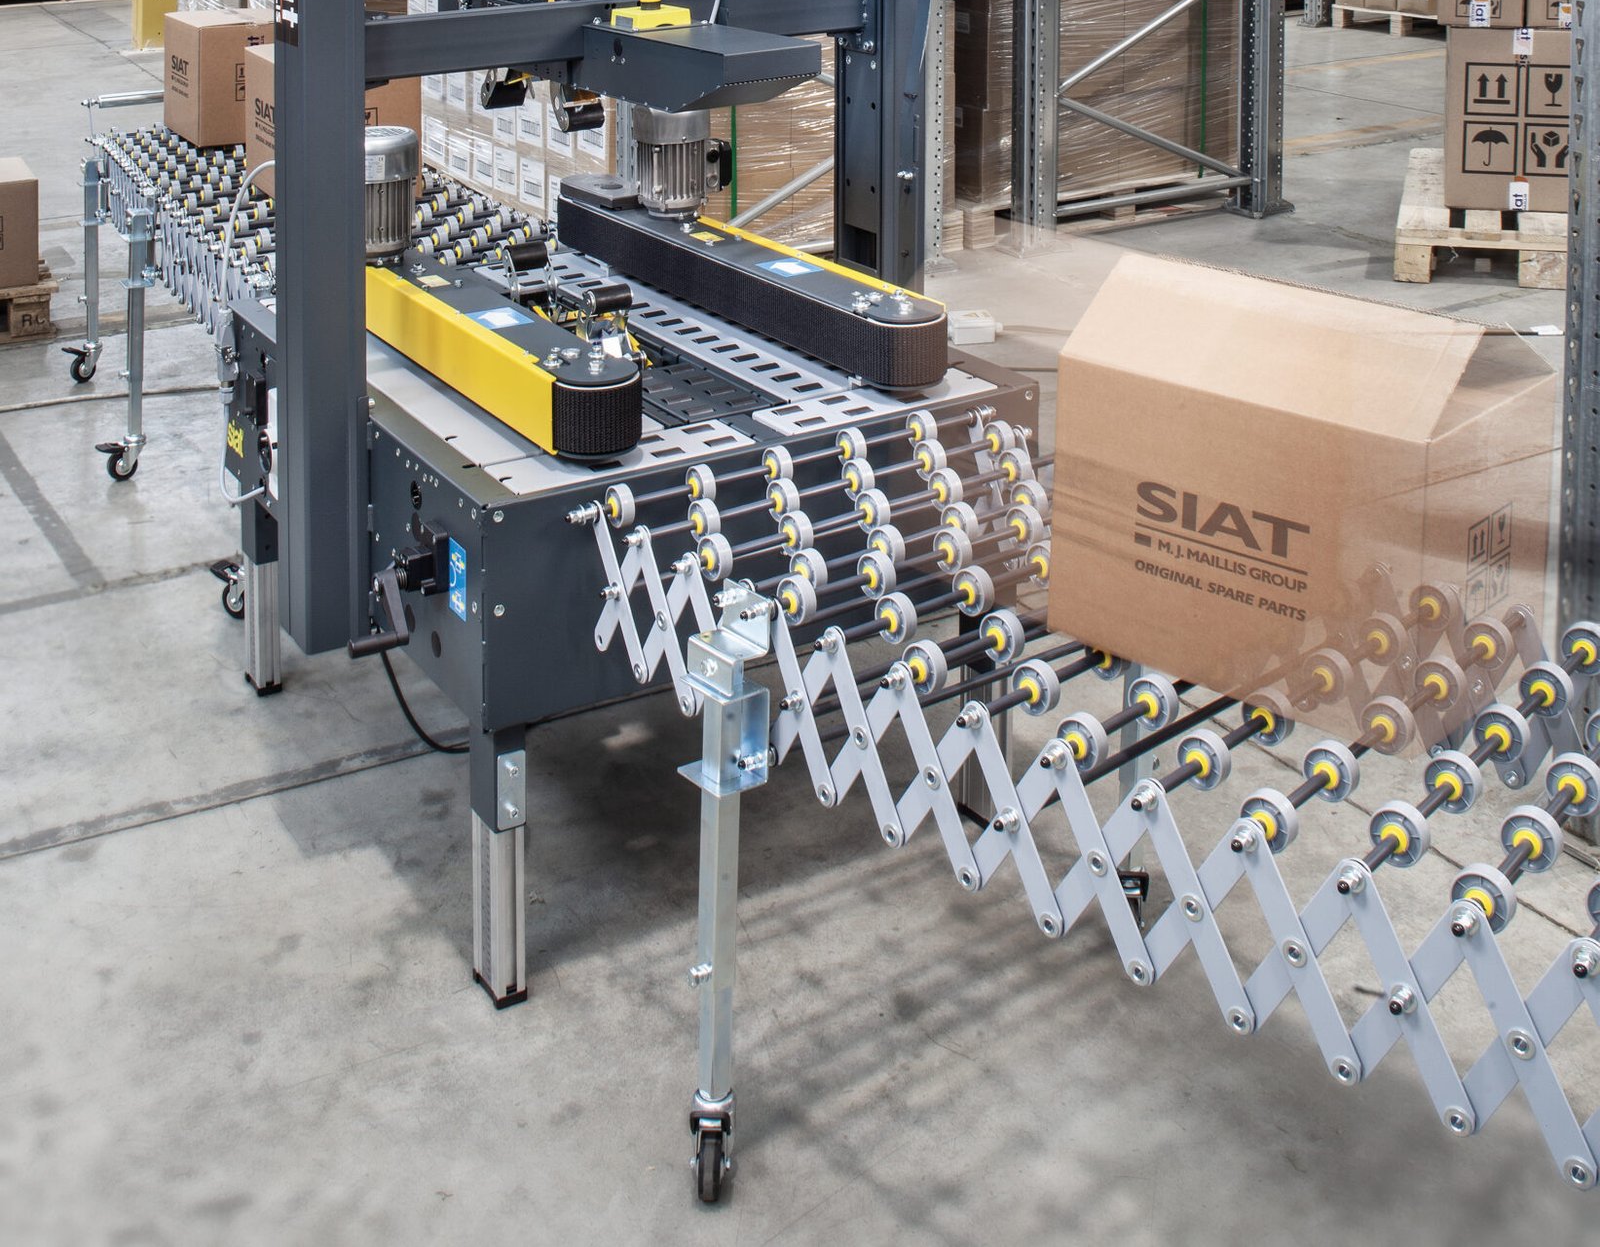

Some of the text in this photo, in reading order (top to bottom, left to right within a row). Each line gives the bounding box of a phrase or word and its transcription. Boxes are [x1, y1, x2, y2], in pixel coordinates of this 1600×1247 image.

[171, 55, 189, 76] SIAT
[1136, 481, 1310, 559] SIAT
[1134, 559, 1307, 622] ORIGINAL SPARE PARTS
[1186, 548, 1247, 576] MAILLIS
[1249, 567, 1308, 593] GROUP
